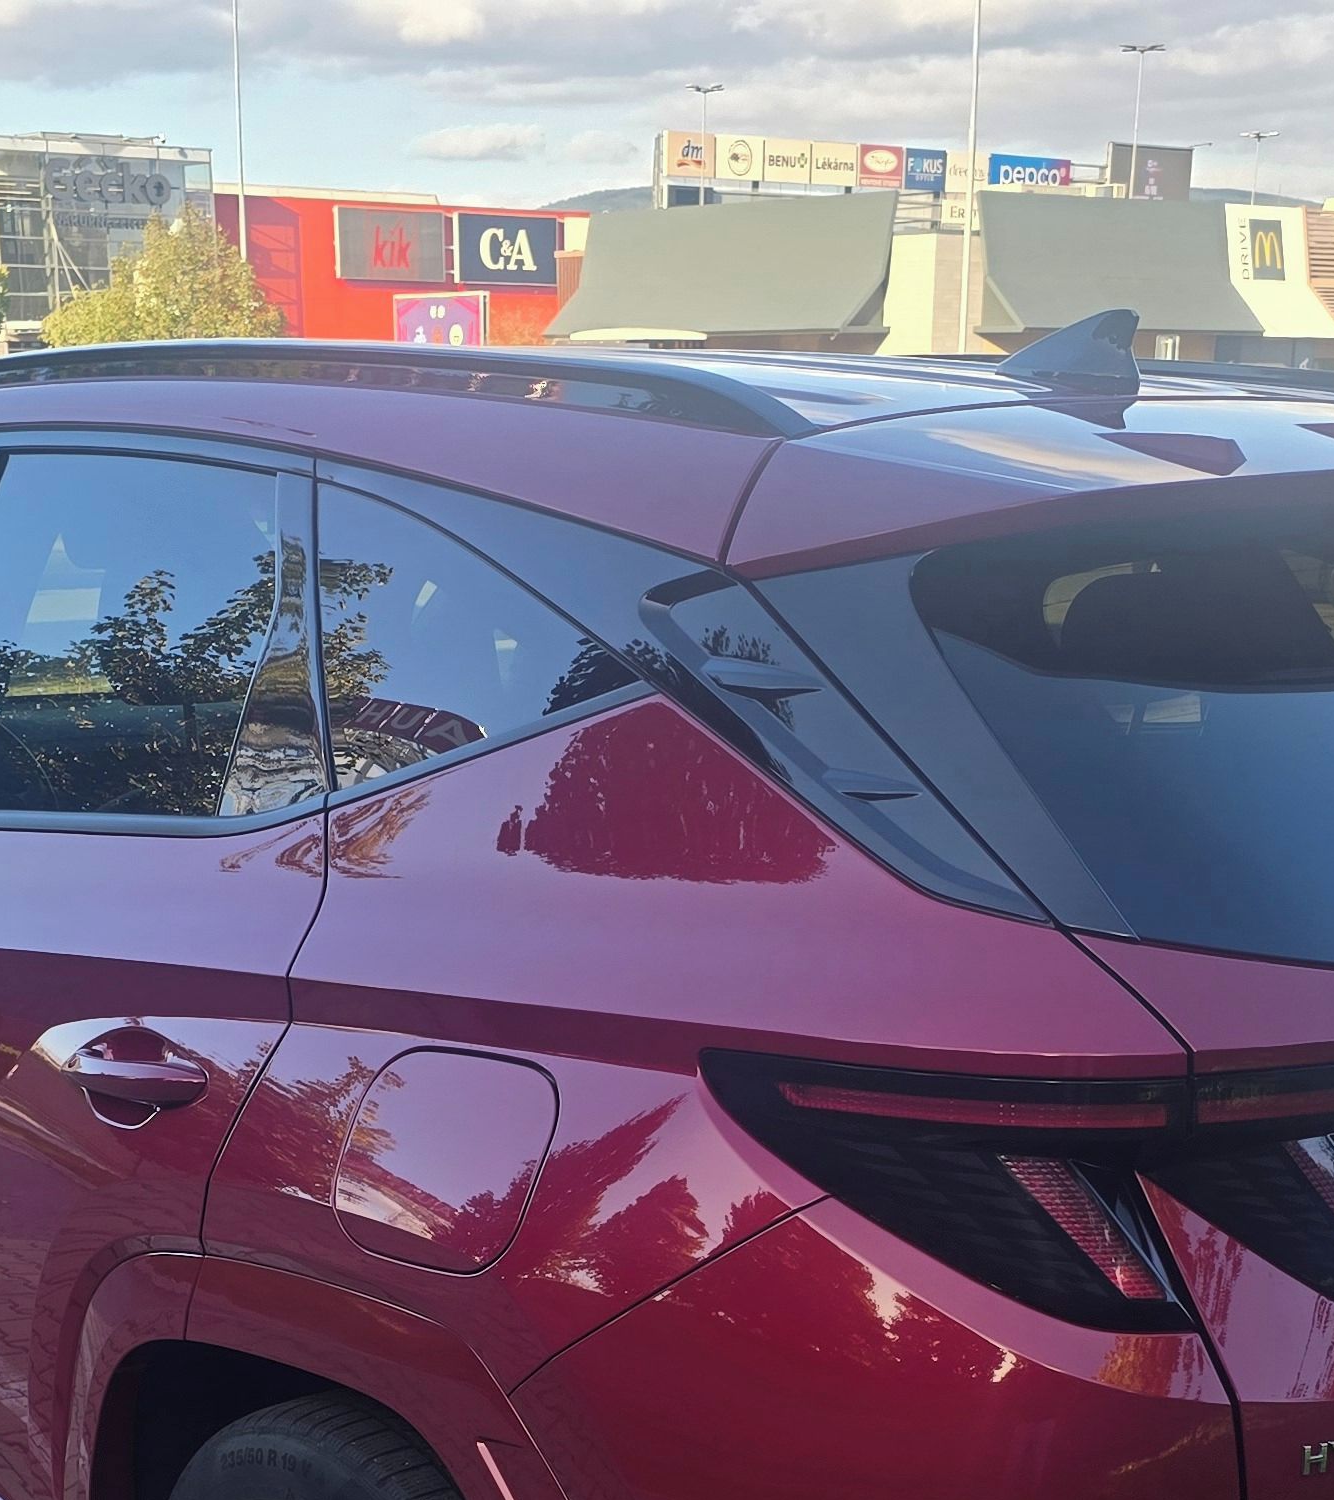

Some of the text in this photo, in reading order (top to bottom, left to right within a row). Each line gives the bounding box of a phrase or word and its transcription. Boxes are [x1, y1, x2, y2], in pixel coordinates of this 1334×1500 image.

[682, 140, 703, 158] dm
[768, 154, 796, 168] BENU
[816, 157, 854, 172] Lékárna
[1000, 164, 1061, 185] pepco
[479, 228, 537, 271] C&A
[1237, 217, 1250, 280] DRIVE
